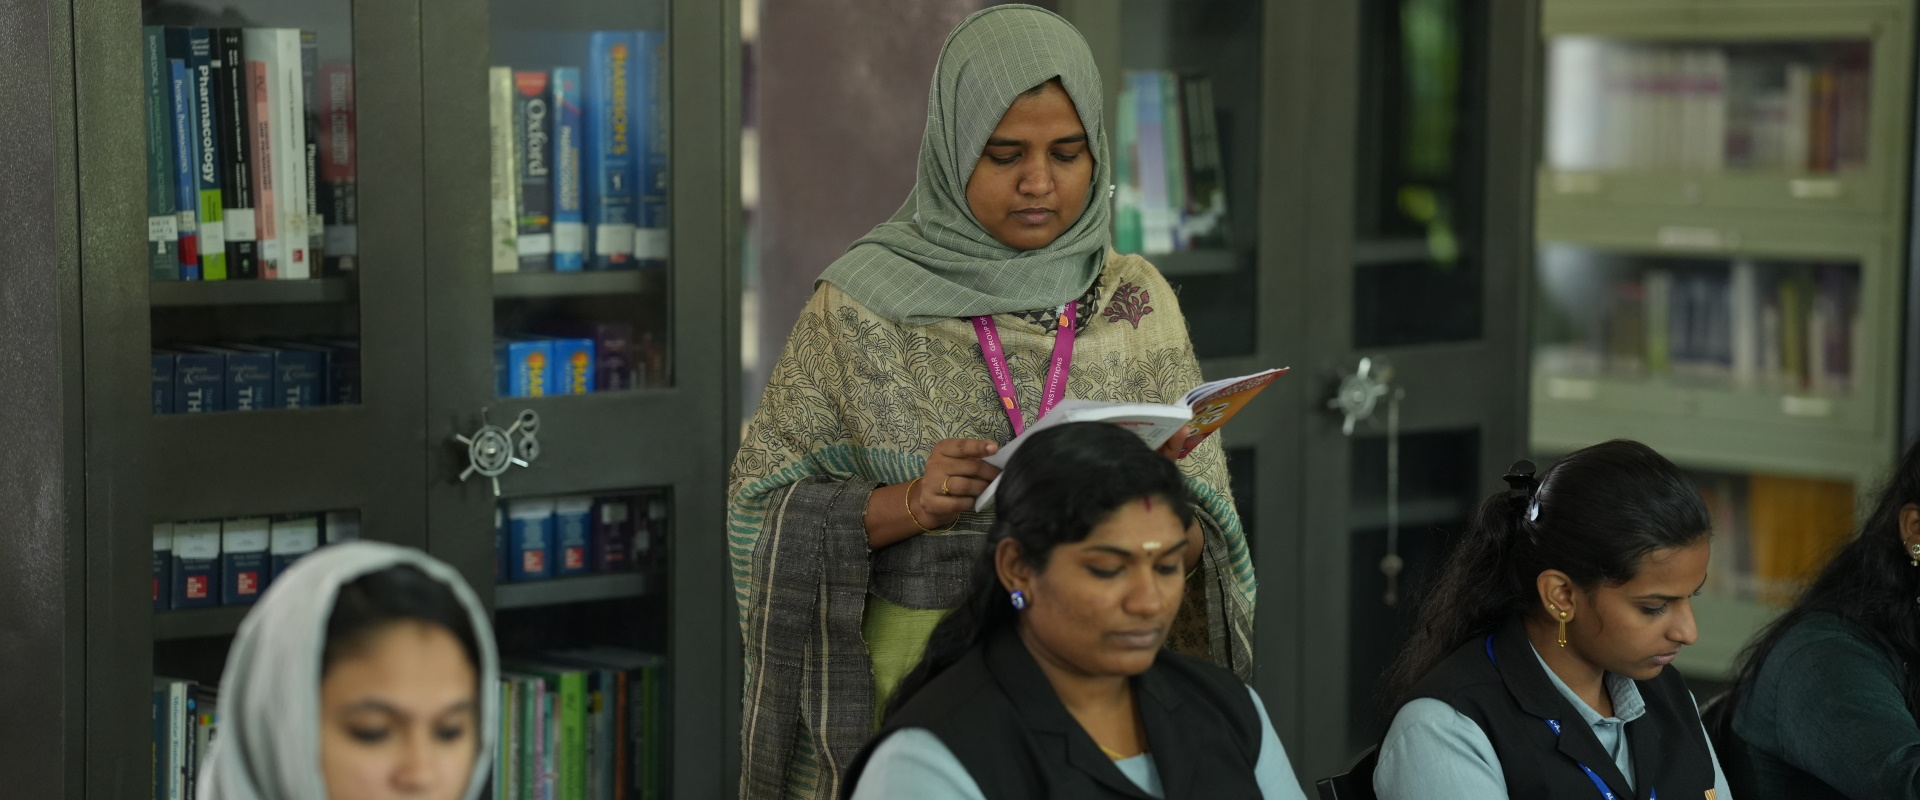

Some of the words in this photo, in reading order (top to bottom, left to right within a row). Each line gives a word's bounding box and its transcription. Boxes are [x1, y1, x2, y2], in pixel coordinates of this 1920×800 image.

[150, 34, 159, 88] BIOMEDICAL
[199, 64, 214, 183] Pharmacology
[527, 98, 548, 176] Oxford
[980, 316, 988, 325] OF
[984, 326, 997, 352] GROUP
[1047, 357, 1063, 406] INSTITUTIONS
